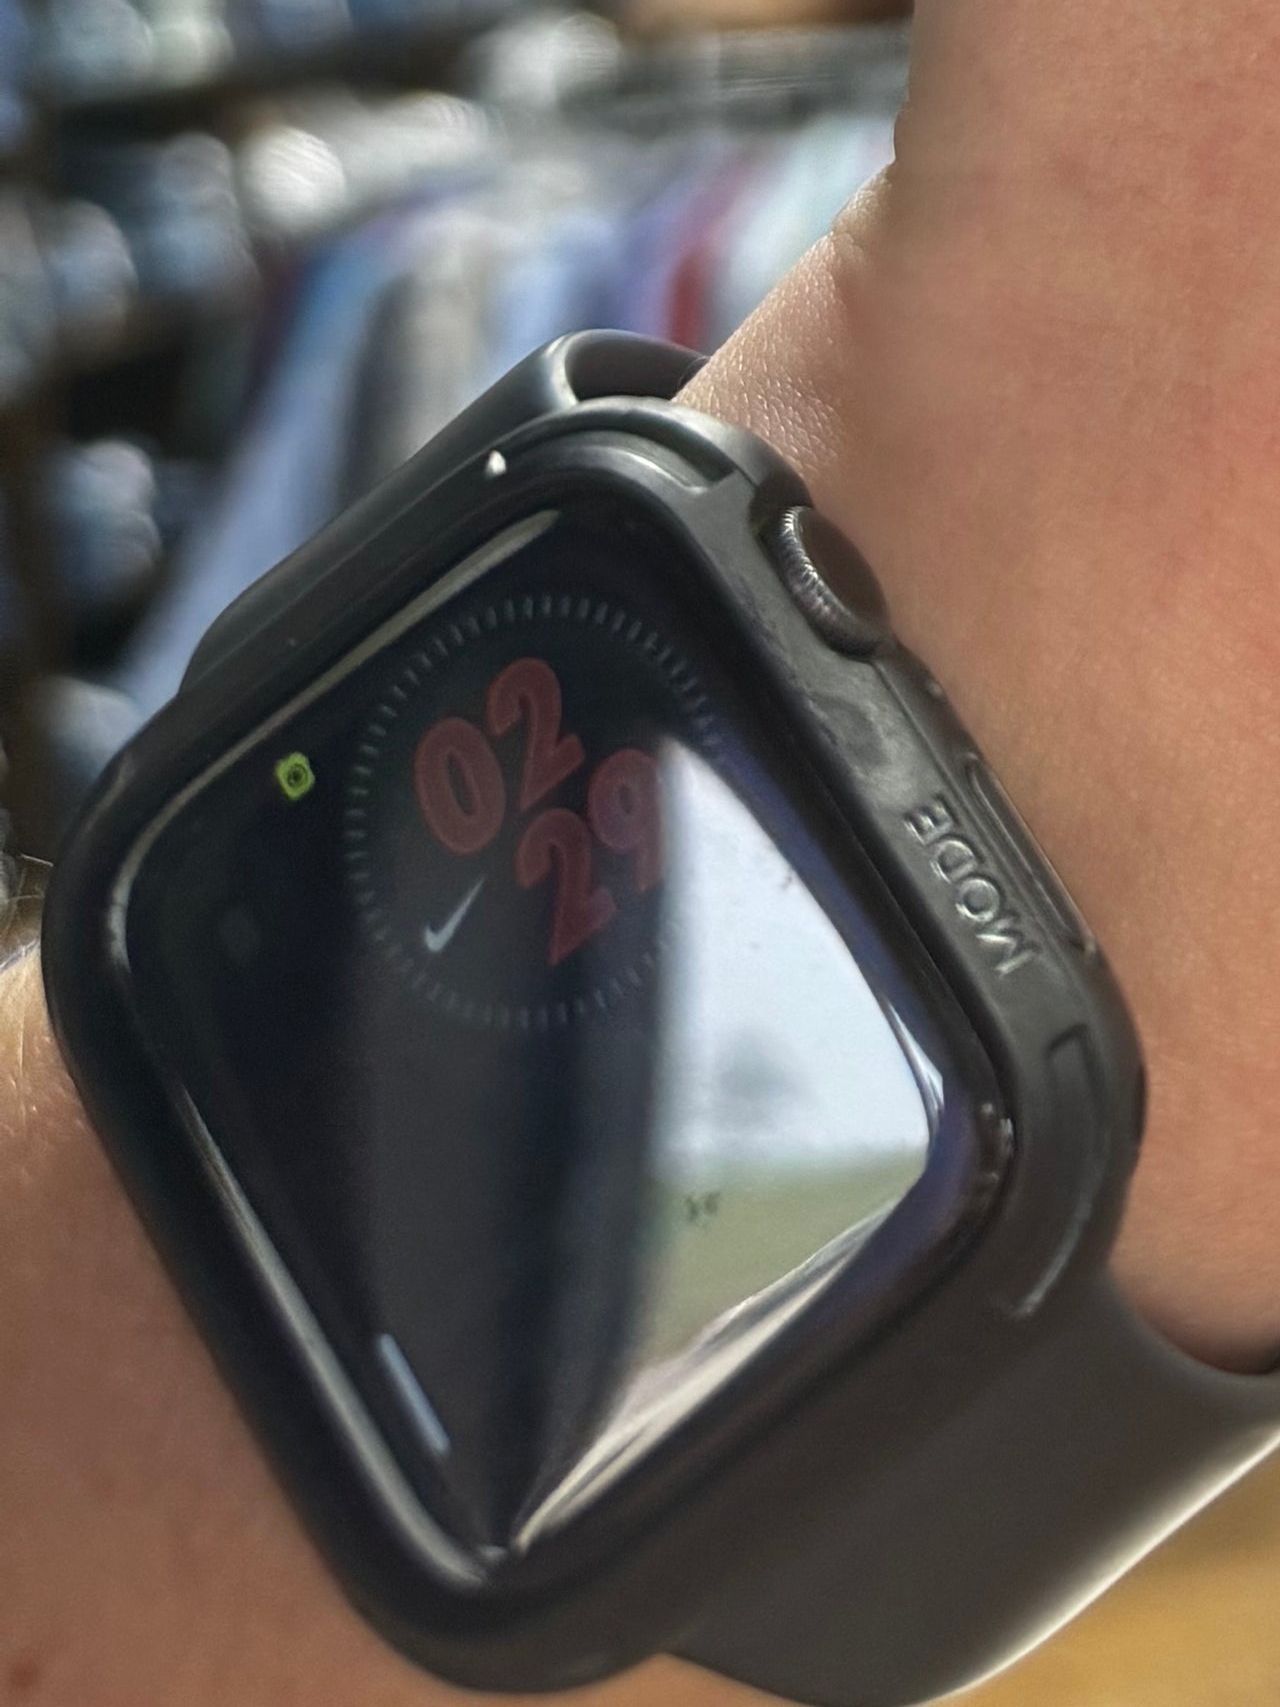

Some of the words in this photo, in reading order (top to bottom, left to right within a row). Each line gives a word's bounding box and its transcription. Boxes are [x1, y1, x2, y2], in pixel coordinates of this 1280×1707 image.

[414, 657, 586, 856] 02
[514, 748, 666, 967] 29
[902, 796, 1038, 977] MODE
